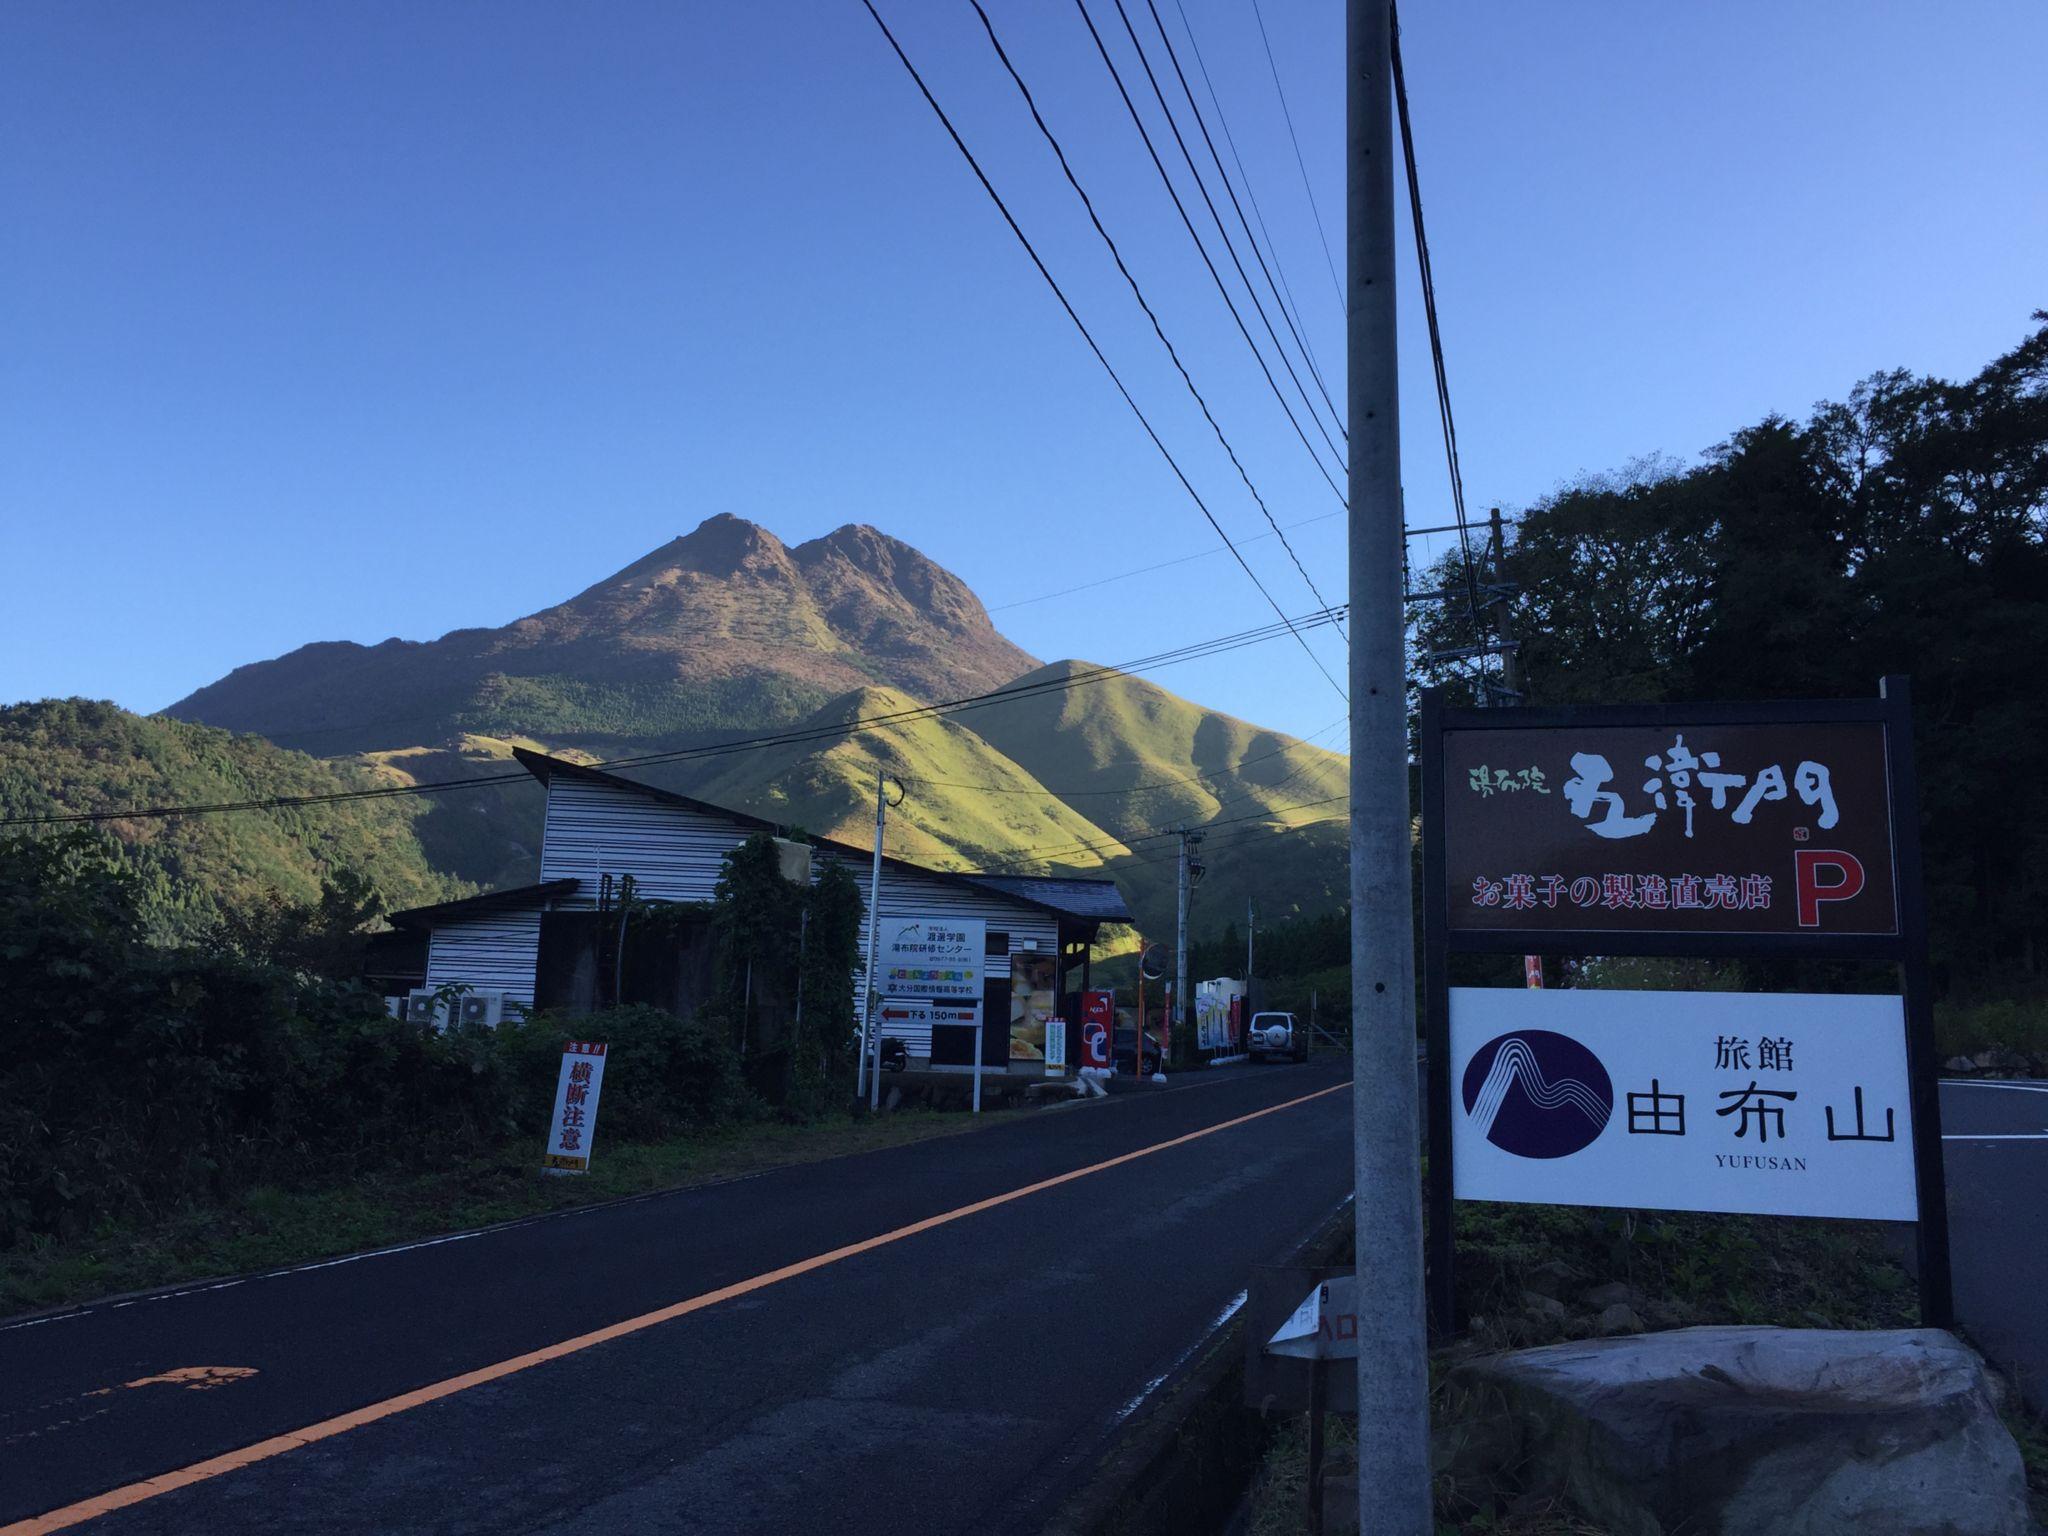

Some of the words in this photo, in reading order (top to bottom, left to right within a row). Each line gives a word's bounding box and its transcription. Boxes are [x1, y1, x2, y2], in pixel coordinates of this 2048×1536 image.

[1472, 872, 1774, 911] お菓子の製造直売店
[1794, 849, 1866, 927] P
[910, 1010, 927, 1020] 下る
[930, 1011, 958, 1020] 150m
[1713, 1035, 1795, 1072] 旅館
[559, 1060, 594, 1151] 横断注意
[1626, 1078, 1895, 1143] 由布山
[1715, 1153, 1808, 1171] YUFUSAN
